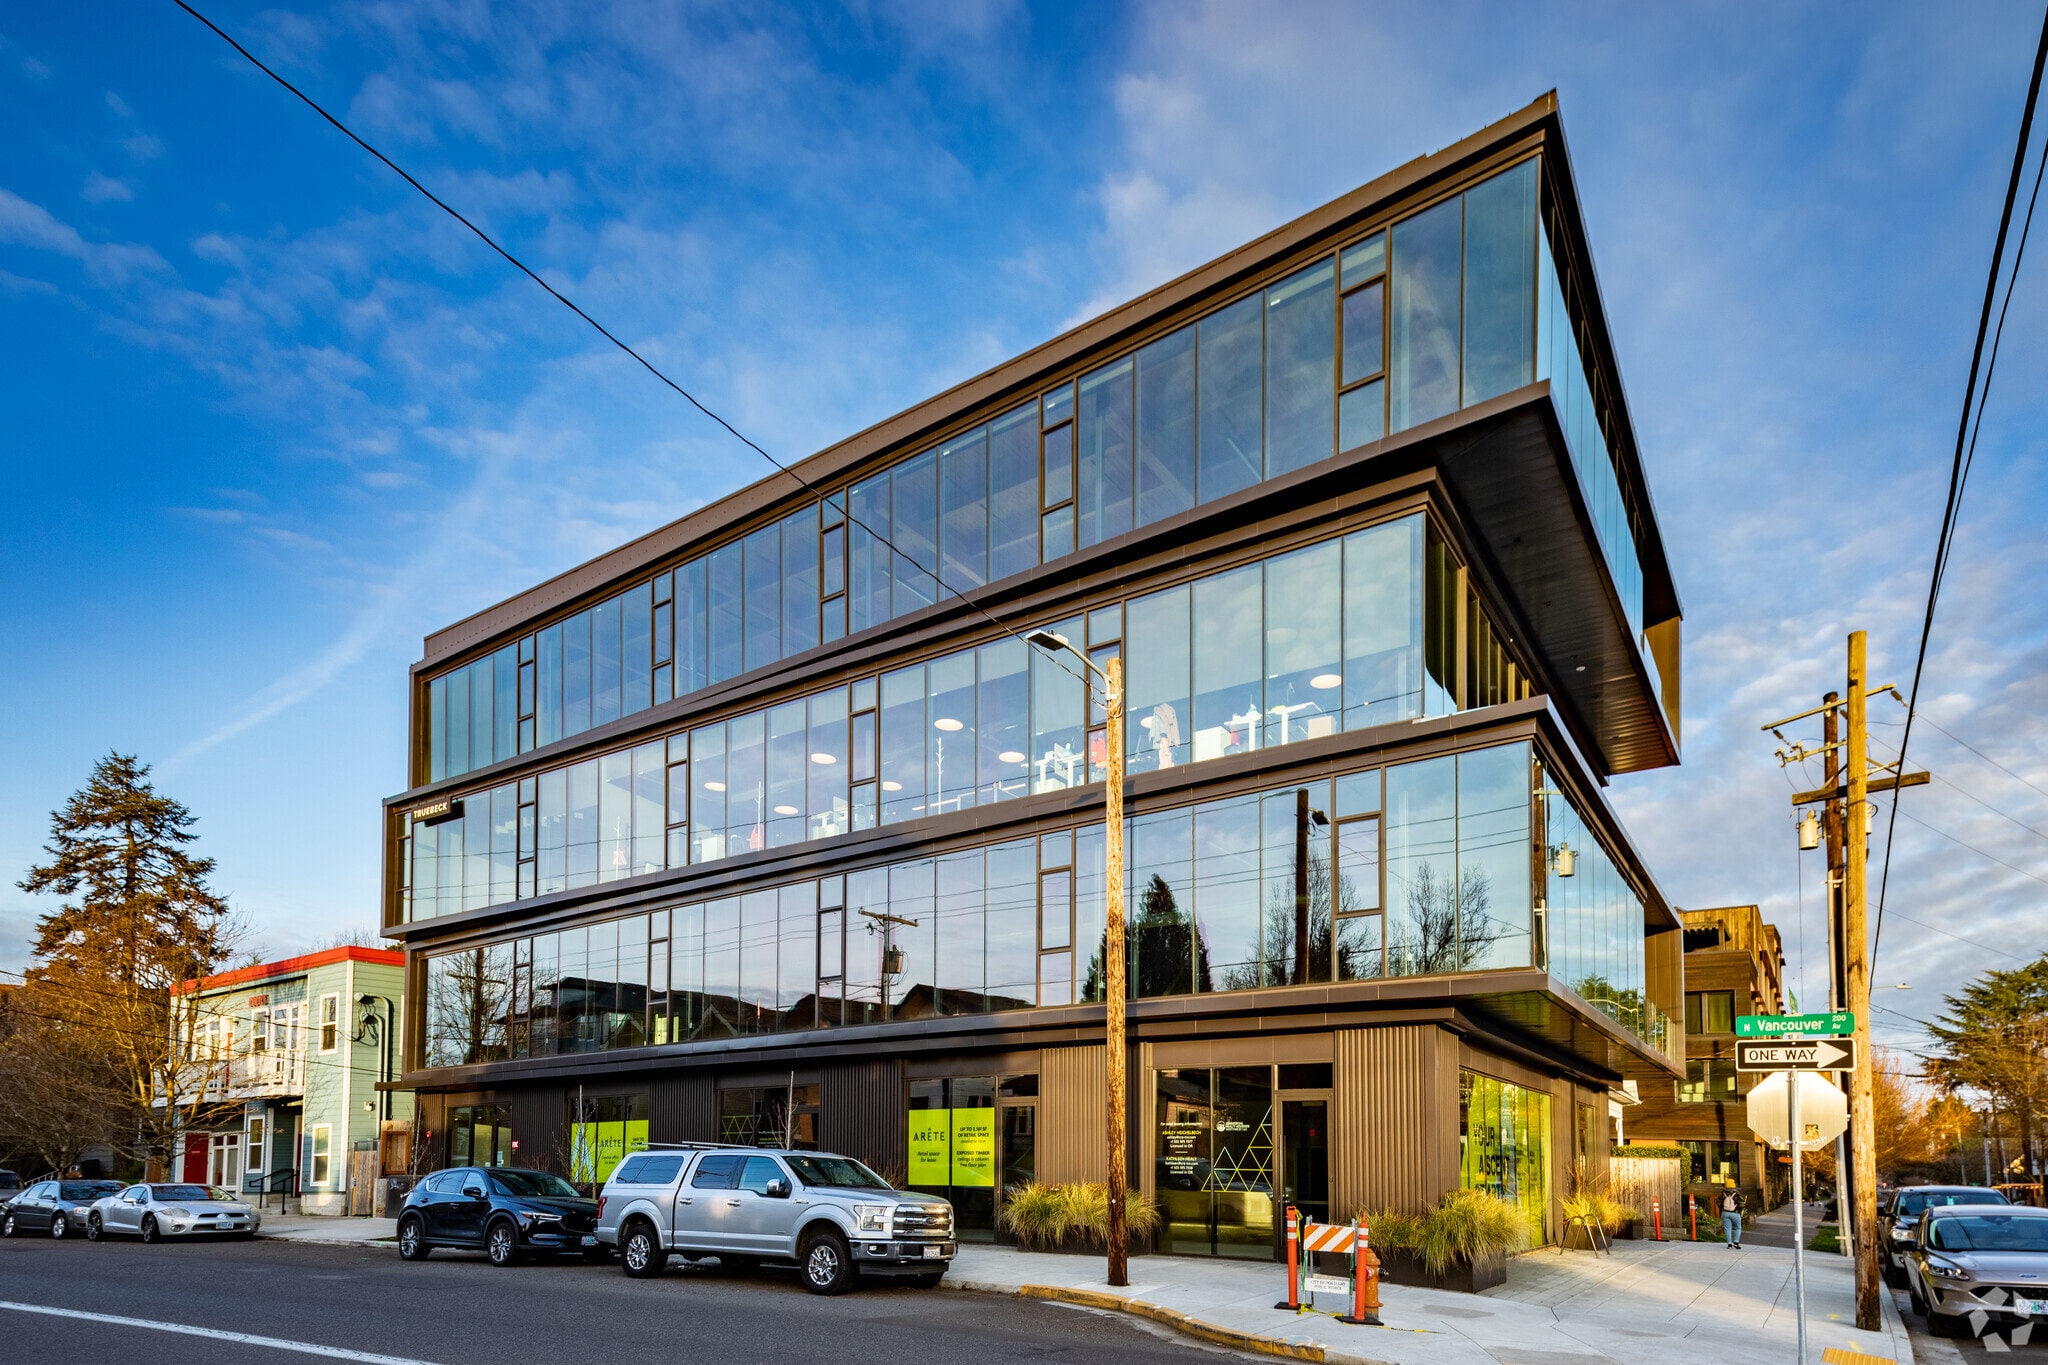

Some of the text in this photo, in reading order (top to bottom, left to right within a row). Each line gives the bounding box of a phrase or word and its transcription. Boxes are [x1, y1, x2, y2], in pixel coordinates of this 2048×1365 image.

[413, 802, 448, 819] TRUEBECK
[1744, 1019, 1824, 1032] N Vancouver
[1749, 1048, 1817, 1061] ONE WAY
[1473, 1124, 1495, 1147] YOUR
